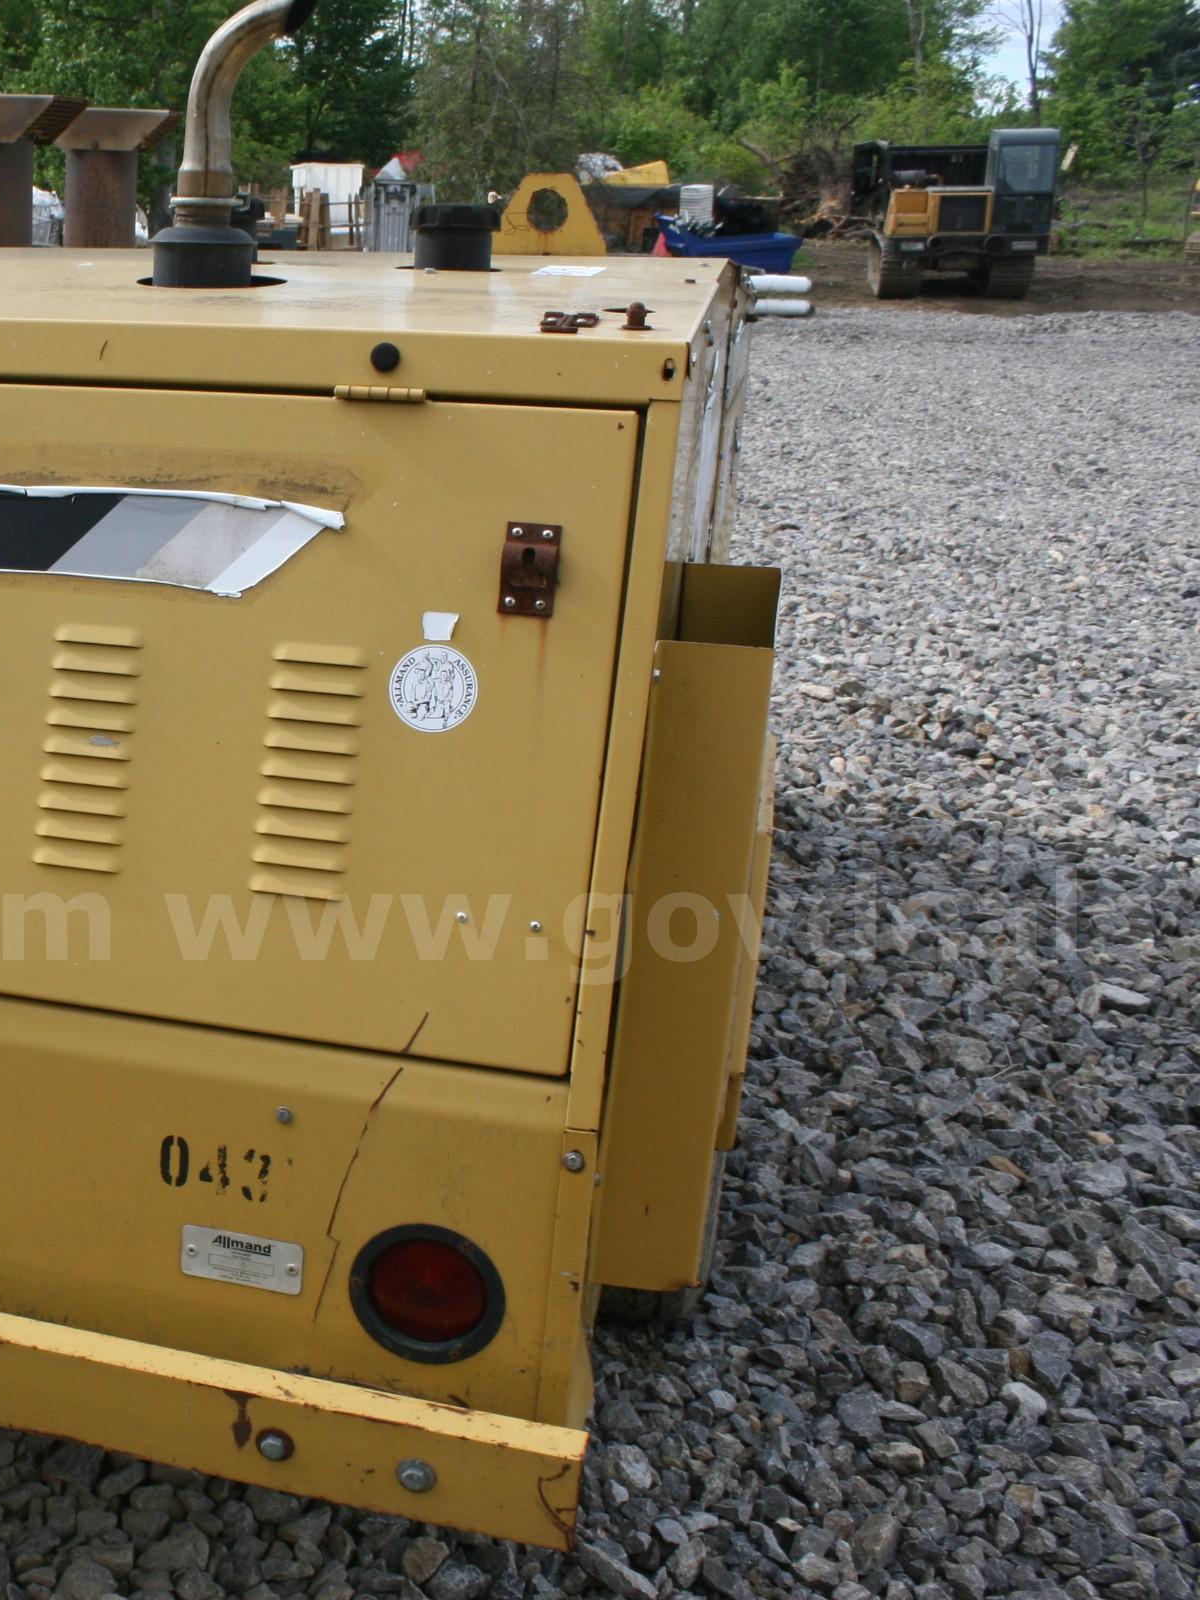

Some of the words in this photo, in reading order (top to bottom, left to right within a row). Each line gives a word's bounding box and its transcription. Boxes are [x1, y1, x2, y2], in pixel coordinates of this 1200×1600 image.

[394, 657, 416, 703] ALLMAND
[453, 658, 473, 717] ASSURANCE
[212, 1235, 272, 1254] Allmand
